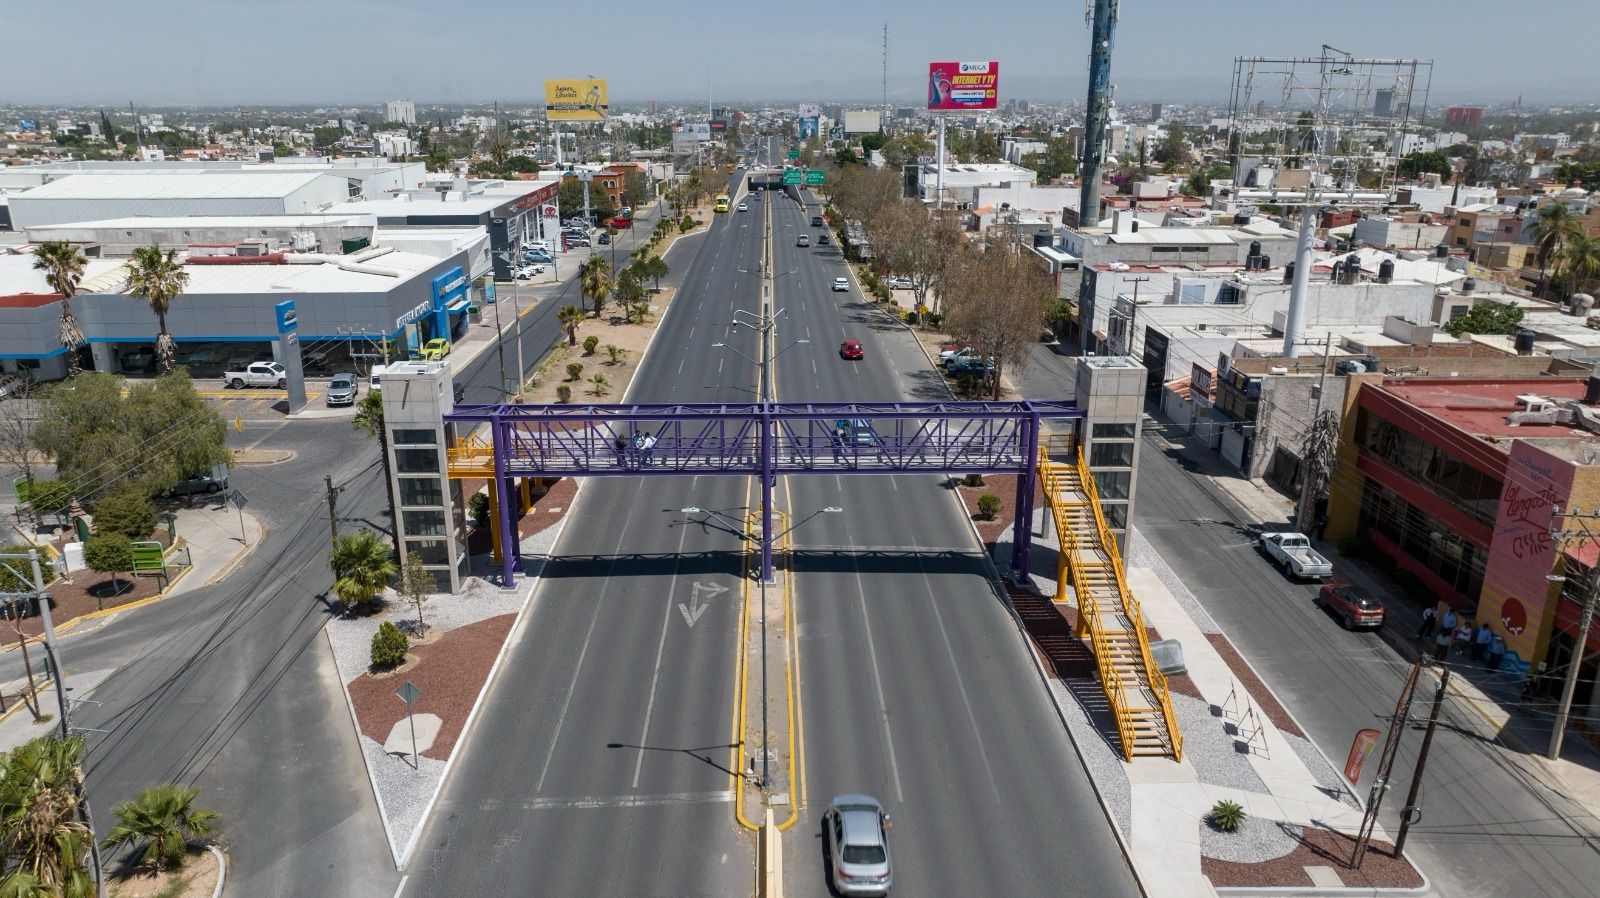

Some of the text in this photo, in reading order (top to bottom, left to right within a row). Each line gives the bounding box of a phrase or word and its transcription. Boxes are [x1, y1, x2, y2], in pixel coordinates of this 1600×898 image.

[952, 75, 995, 84] INTERNET Y TV
